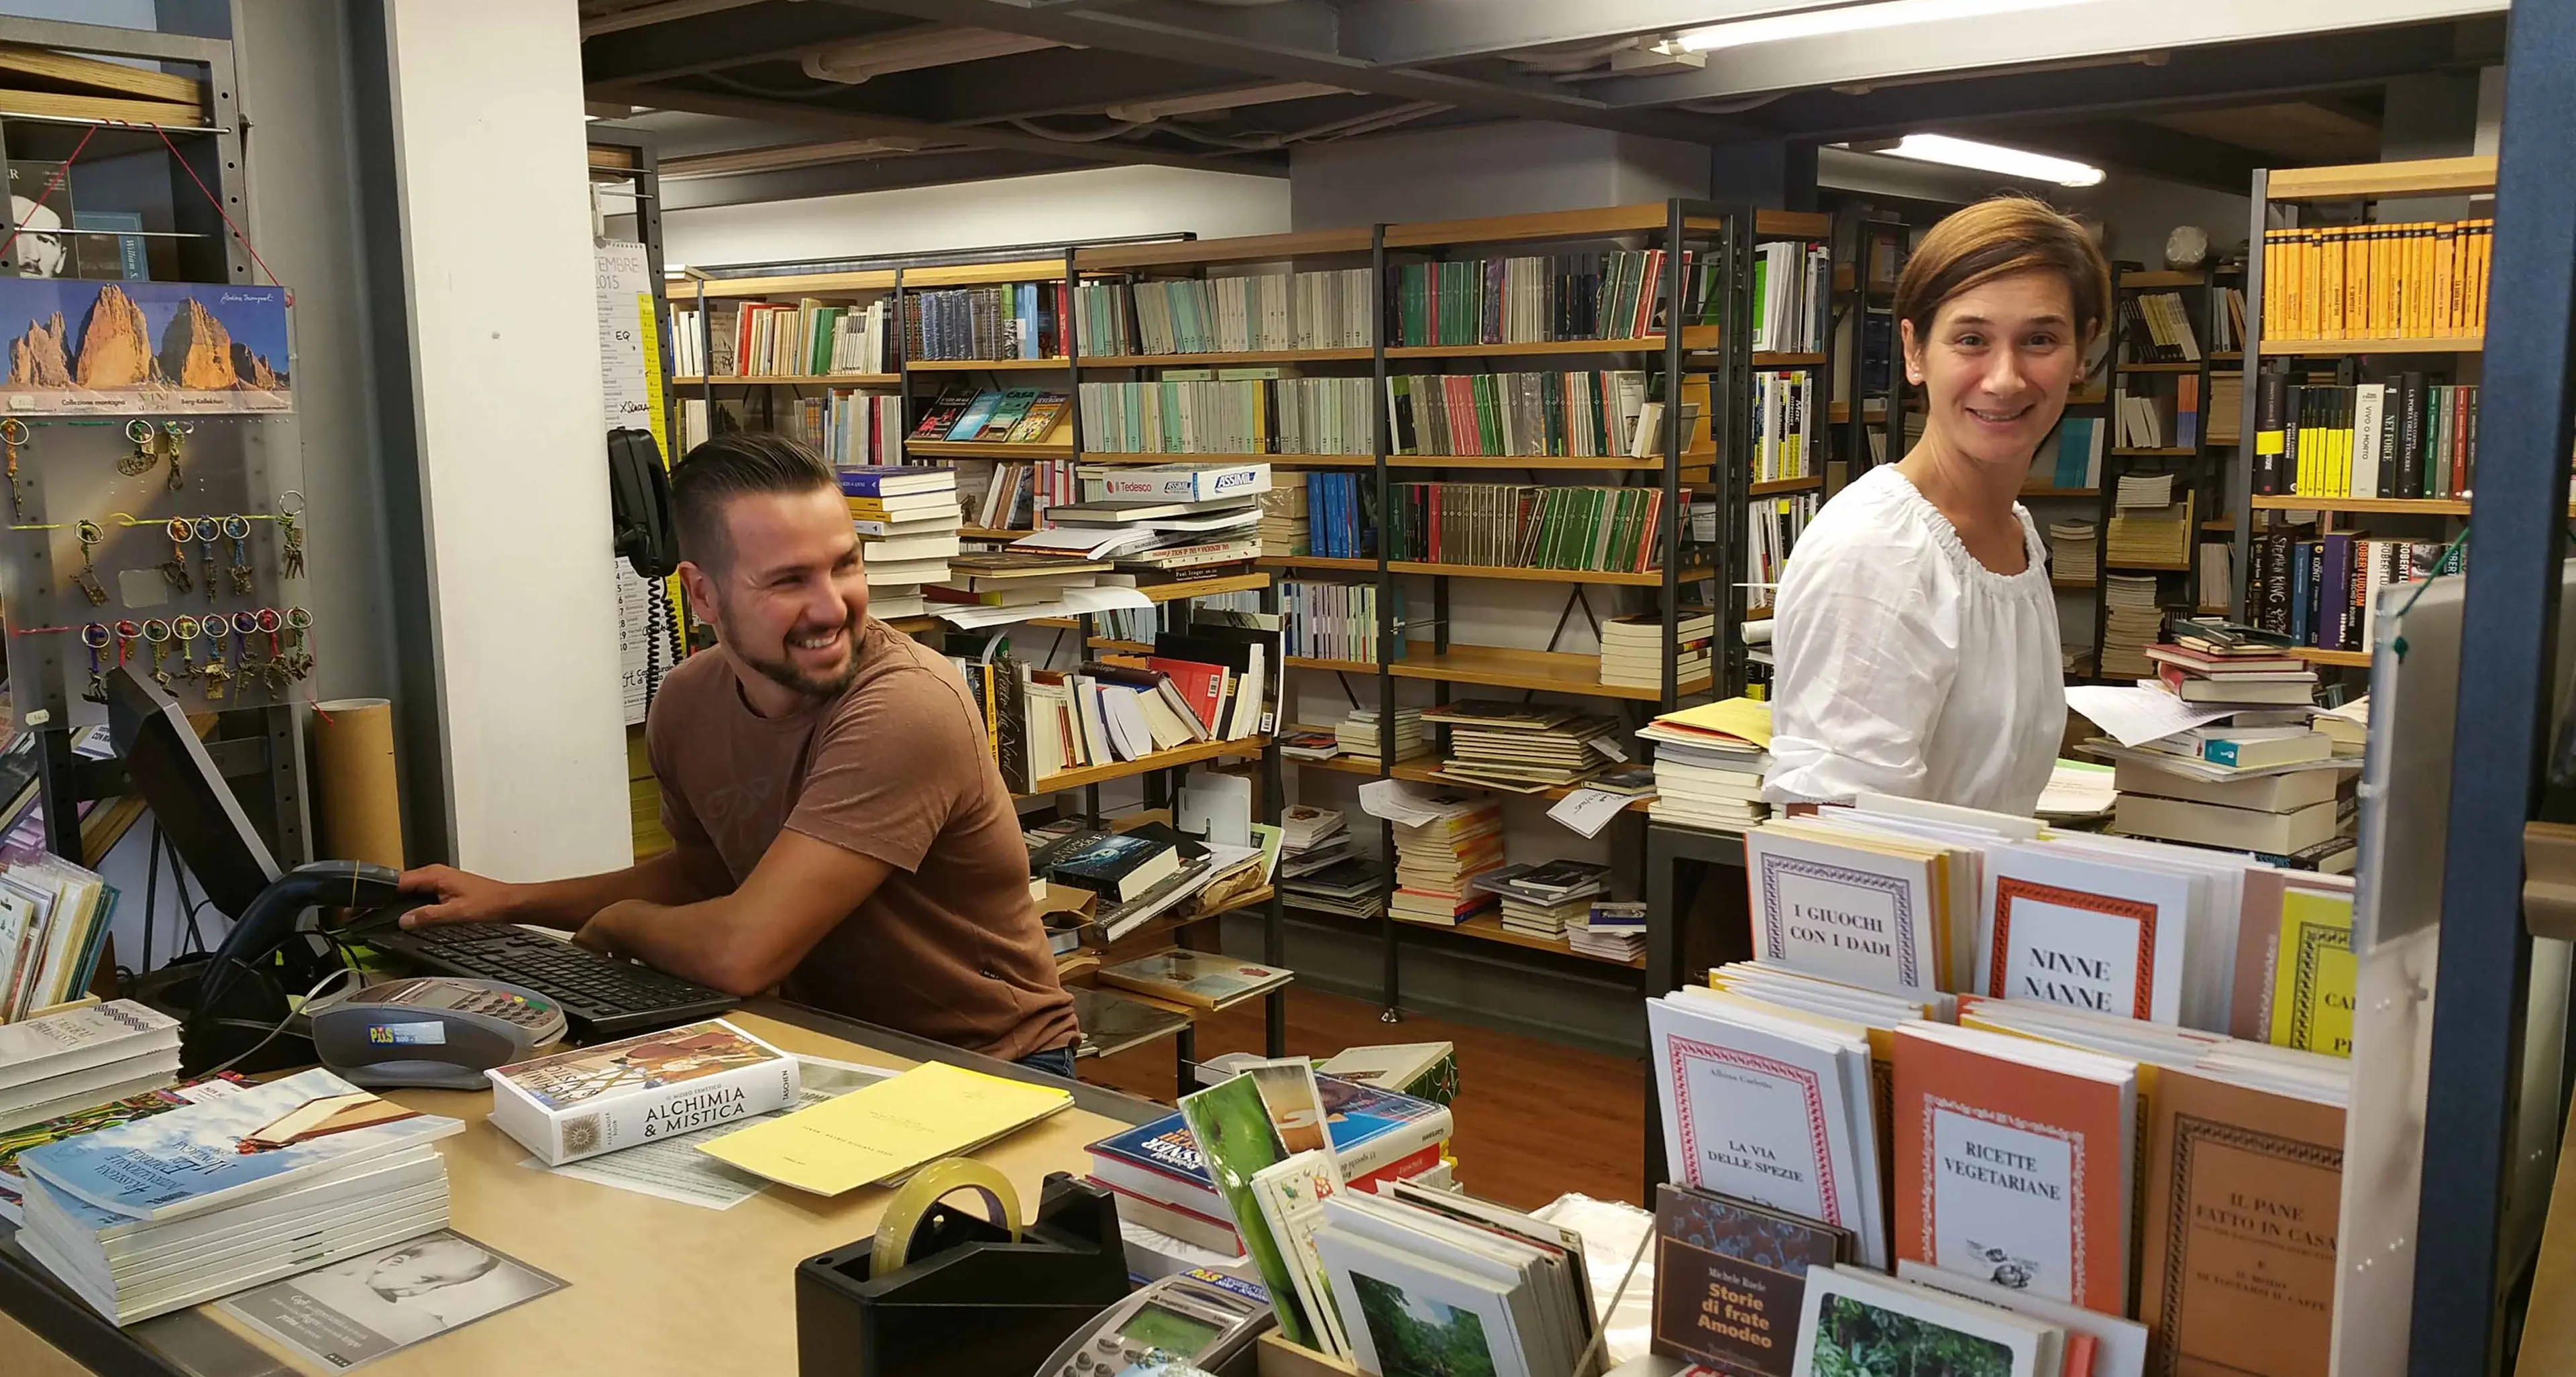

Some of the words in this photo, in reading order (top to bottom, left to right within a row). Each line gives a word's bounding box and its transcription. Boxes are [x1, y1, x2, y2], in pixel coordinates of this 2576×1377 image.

[2364, 405, 2372, 425] VIVO
[2385, 415, 2395, 432] NET
[2361, 434, 2369, 460] MORTO
[2382, 433, 2394, 463] FORCE
[1120, 482, 1152, 492] Tedesco
[2271, 537, 2287, 573] STEPHEN
[2312, 557, 2321, 582] KOONTZ
[2358, 541, 2369, 572] ROBERT
[2379, 543, 2392, 574] ROBERT
[2399, 543, 2410, 575] ROBERT
[2269, 576, 2286, 603] KING
[2355, 573, 2367, 606] LUDLUM
[1000, 732, 1024, 783] Nord
[1794, 904, 1801, 918] I
[1807, 907, 1884, 934] GIUOCHI
[1790, 926, 1825, 948] CON
[1832, 934, 1839, 947] I
[1846, 938, 1892, 958] DADI
[2029, 946, 2111, 982] NINNE
[2024, 975, 2112, 1011] NANNE
[782, 1069, 790, 1102] TASCHEN
[644, 1123, 656, 1138] &
[665, 1102, 745, 1133] MISTICA
[645, 1085, 746, 1123] ALCHIMIA
[1707, 1150, 1752, 1170] DELLE
[1754, 1162, 1804, 1182] SPEZIE
[1729, 1140, 1748, 1154] LA
[1750, 1145, 1776, 1161] VIA
[1966, 1141, 2037, 1172] RICETTE
[1944, 1156, 2061, 1201] VEGETARIANE
[2231, 1192, 2248, 1208] IL
[2254, 1198, 2306, 1222] PANE
[2195, 1204, 2255, 1229] FATTO
[2261, 1221, 2281, 1236] IN
[2288, 1228, 2337, 1252] CASA
[1709, 1282, 1764, 1311] Storie
[1701, 1299, 1719, 1315] di
[1725, 1305, 1770, 1331] frate
[1697, 1314, 1773, 1349] Amodeo
